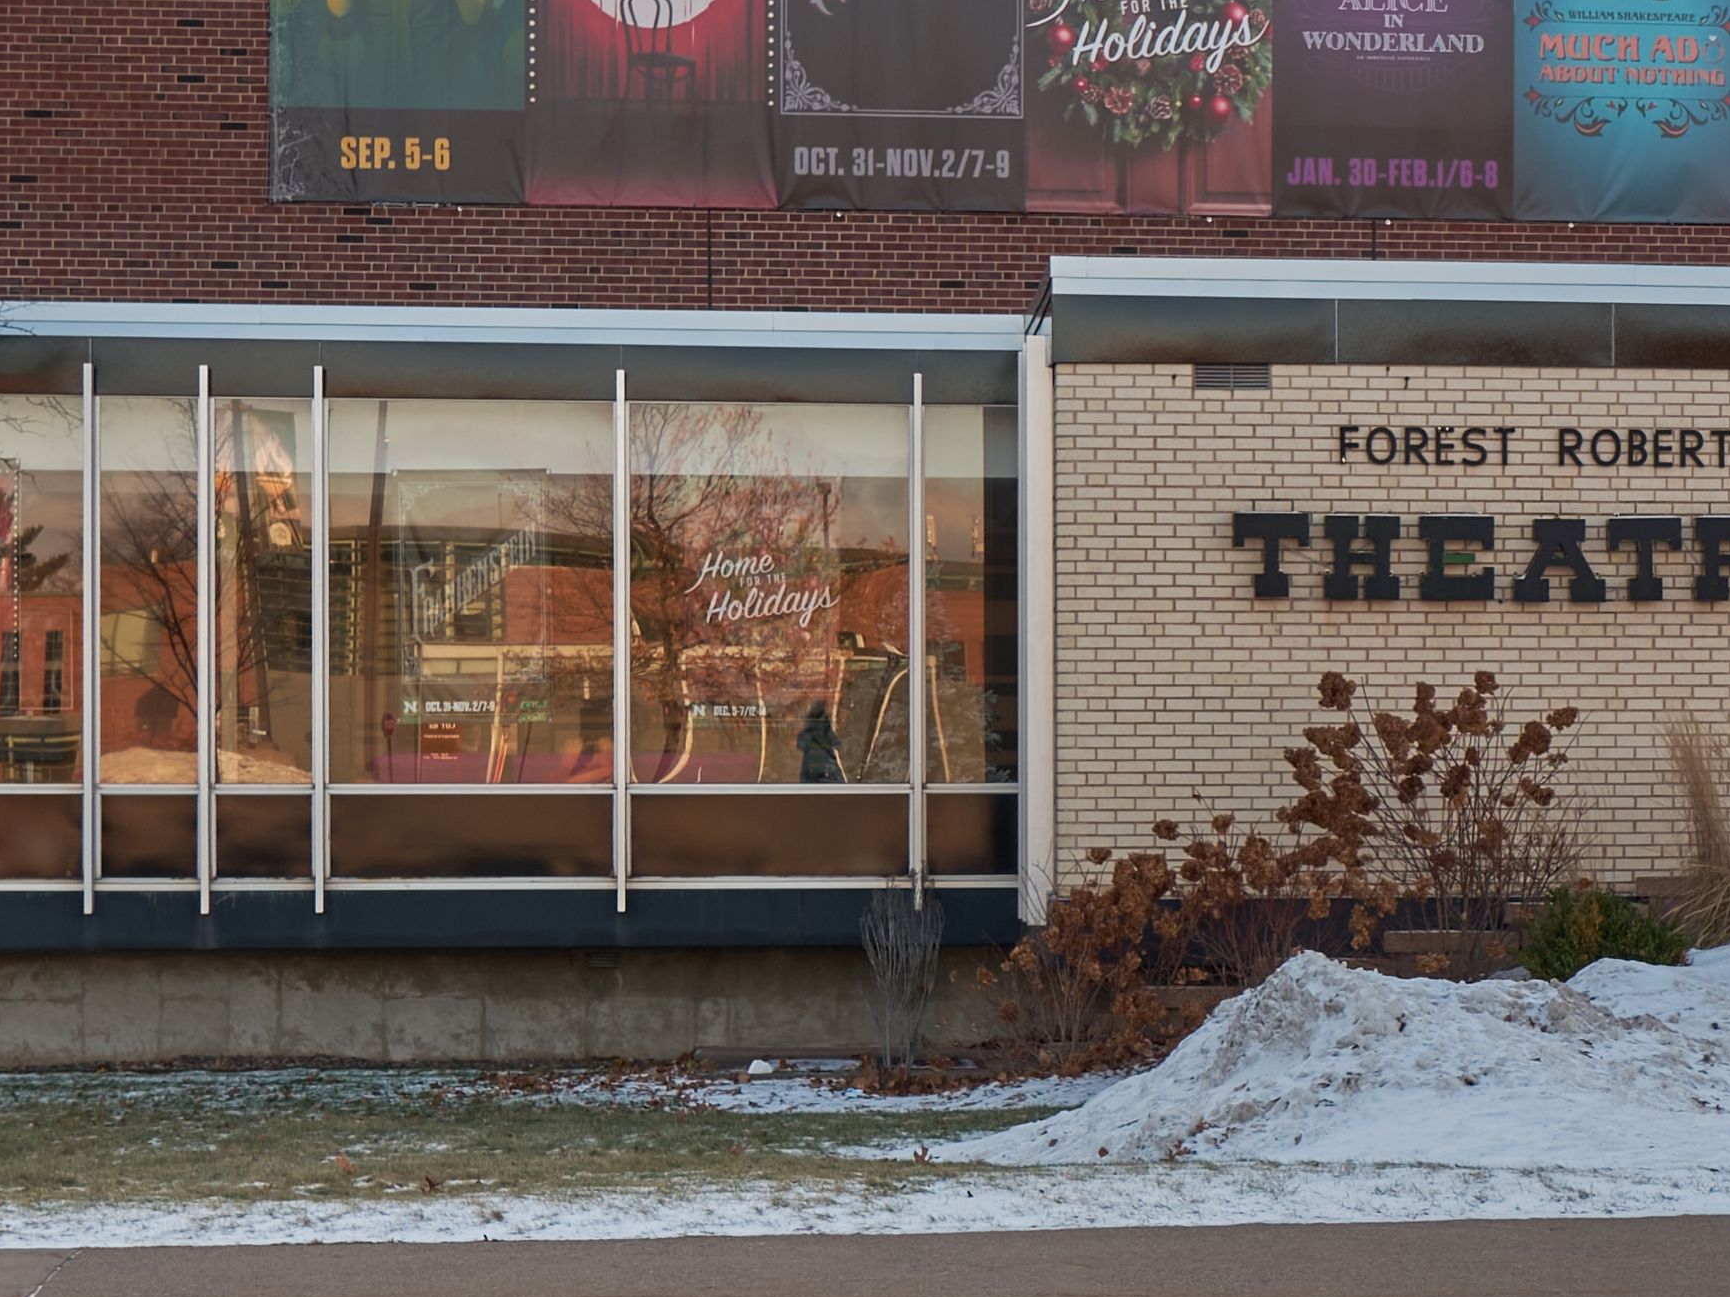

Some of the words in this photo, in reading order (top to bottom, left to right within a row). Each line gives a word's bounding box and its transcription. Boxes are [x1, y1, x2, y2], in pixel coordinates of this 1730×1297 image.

[1120, 0, 1151, 15] FOR
[1383, 13, 1405, 29] IN
[1568, 10, 1615, 21] WILLIAM
[1617, 11, 1695, 23] SHAKESPEARE
[1072, 9, 1270, 74] Holidays
[1302, 31, 1485, 54] WONDERLAND
[1539, 32, 1640, 63] MUCH
[1539, 64, 1620, 84] ABOUT
[1626, 67, 1726, 87] NOTHING
[340, 136, 396, 170] SEP.
[405, 137, 450, 170] 5-6
[794, 146, 844, 176] OCT.
[1287, 157, 1341, 186] JAN.
[1339, 425, 1516, 465] FOREST
[684, 551, 775, 594] Home
[740, 577, 761, 587] FOR
[767, 572, 787, 584] THE
[706, 583, 840, 627] Holidays
